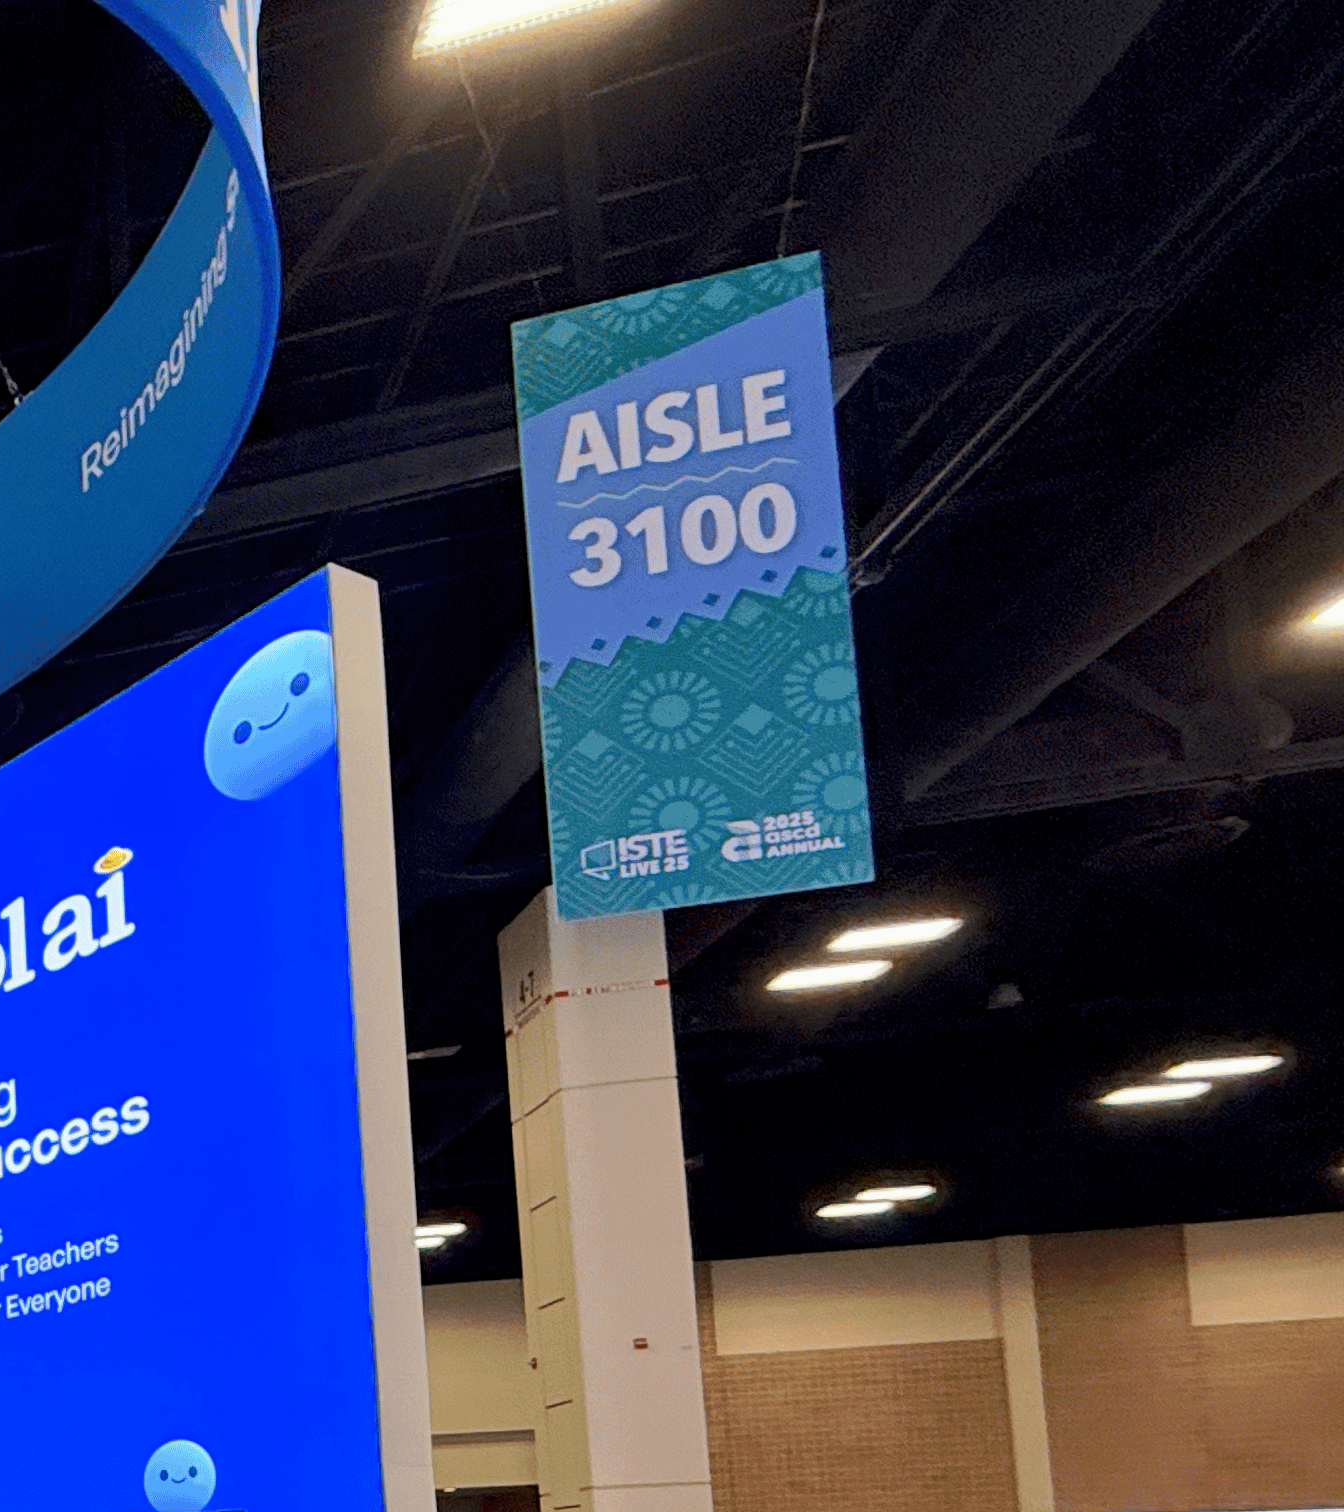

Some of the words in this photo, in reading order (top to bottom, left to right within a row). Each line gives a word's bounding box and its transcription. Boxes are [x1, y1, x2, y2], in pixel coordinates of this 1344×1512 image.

[556, 368, 791, 483] AISLE
[568, 482, 797, 588] 3100
[763, 810, 815, 831] 2025
[618, 829, 690, 862] ISTE
[766, 836, 846, 858] ANNUAL
[620, 858, 661, 878] LIVE
[663, 855, 689, 872] 25
[10, 1233, 120, 1278] Teachers
[6, 1276, 112, 1319] Everyone
